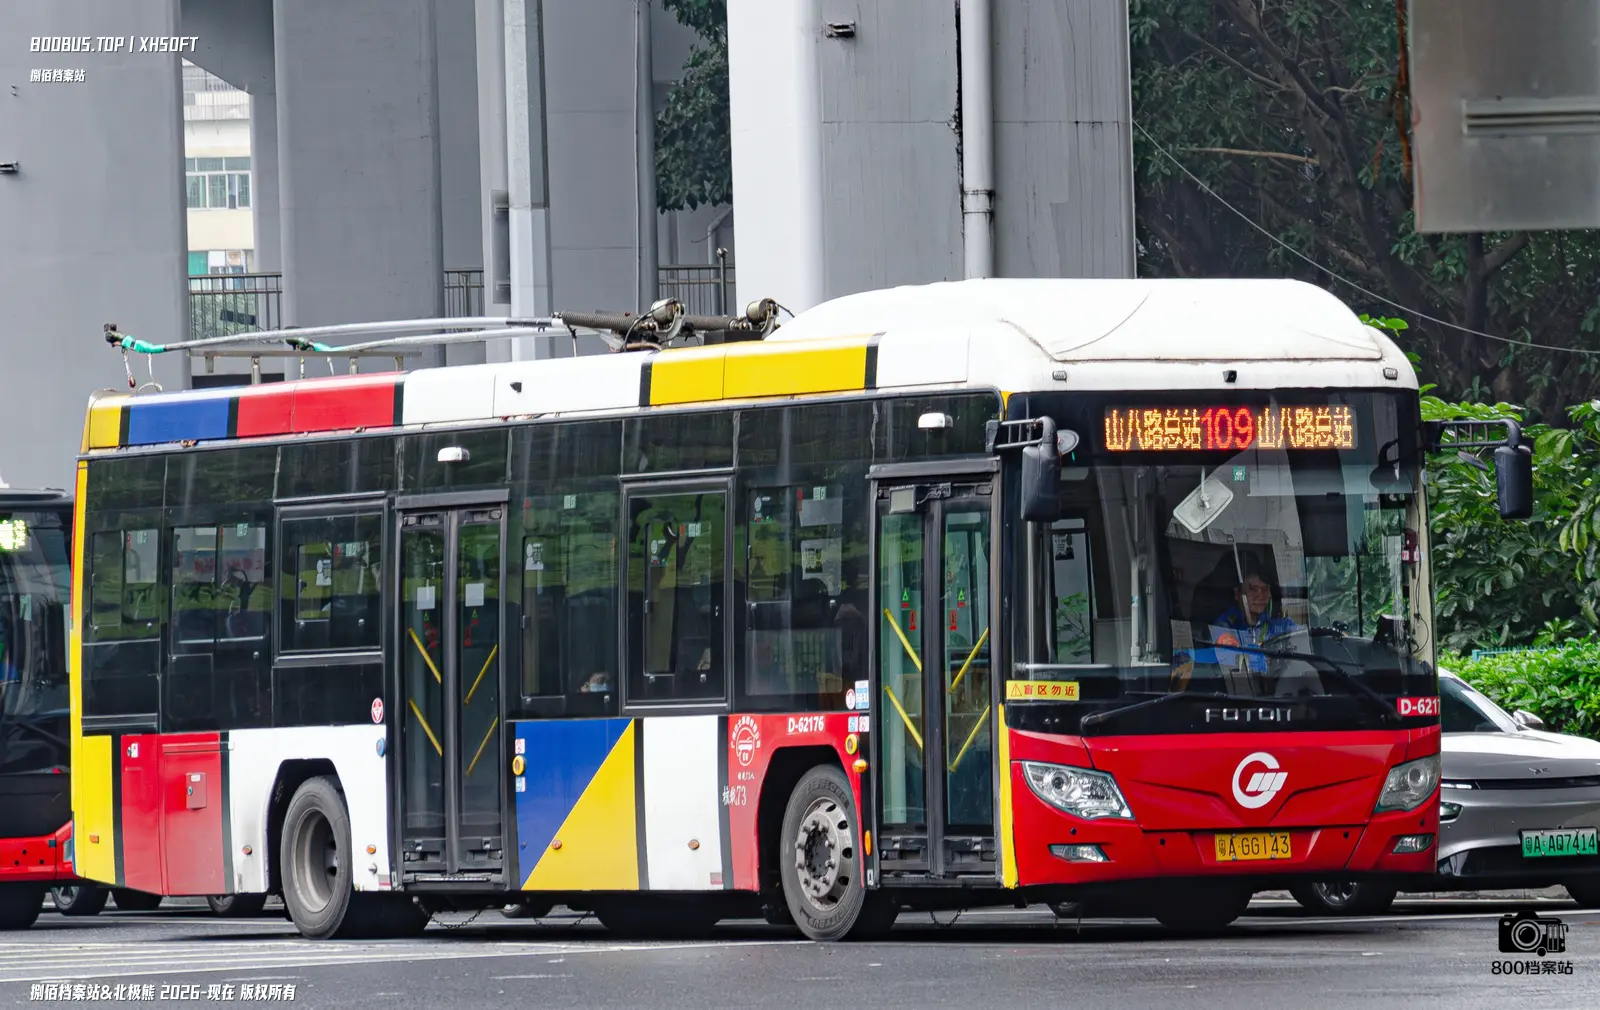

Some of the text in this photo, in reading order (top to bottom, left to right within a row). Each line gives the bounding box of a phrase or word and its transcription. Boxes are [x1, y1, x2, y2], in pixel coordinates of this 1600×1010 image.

[1105, 407, 1353, 451] 山八路总站 109 山八路总站
[1024, 684, 1075, 696] 盲区勿近
[1205, 708, 1291, 722] FOTON
[788, 716, 824, 732] D-62176
